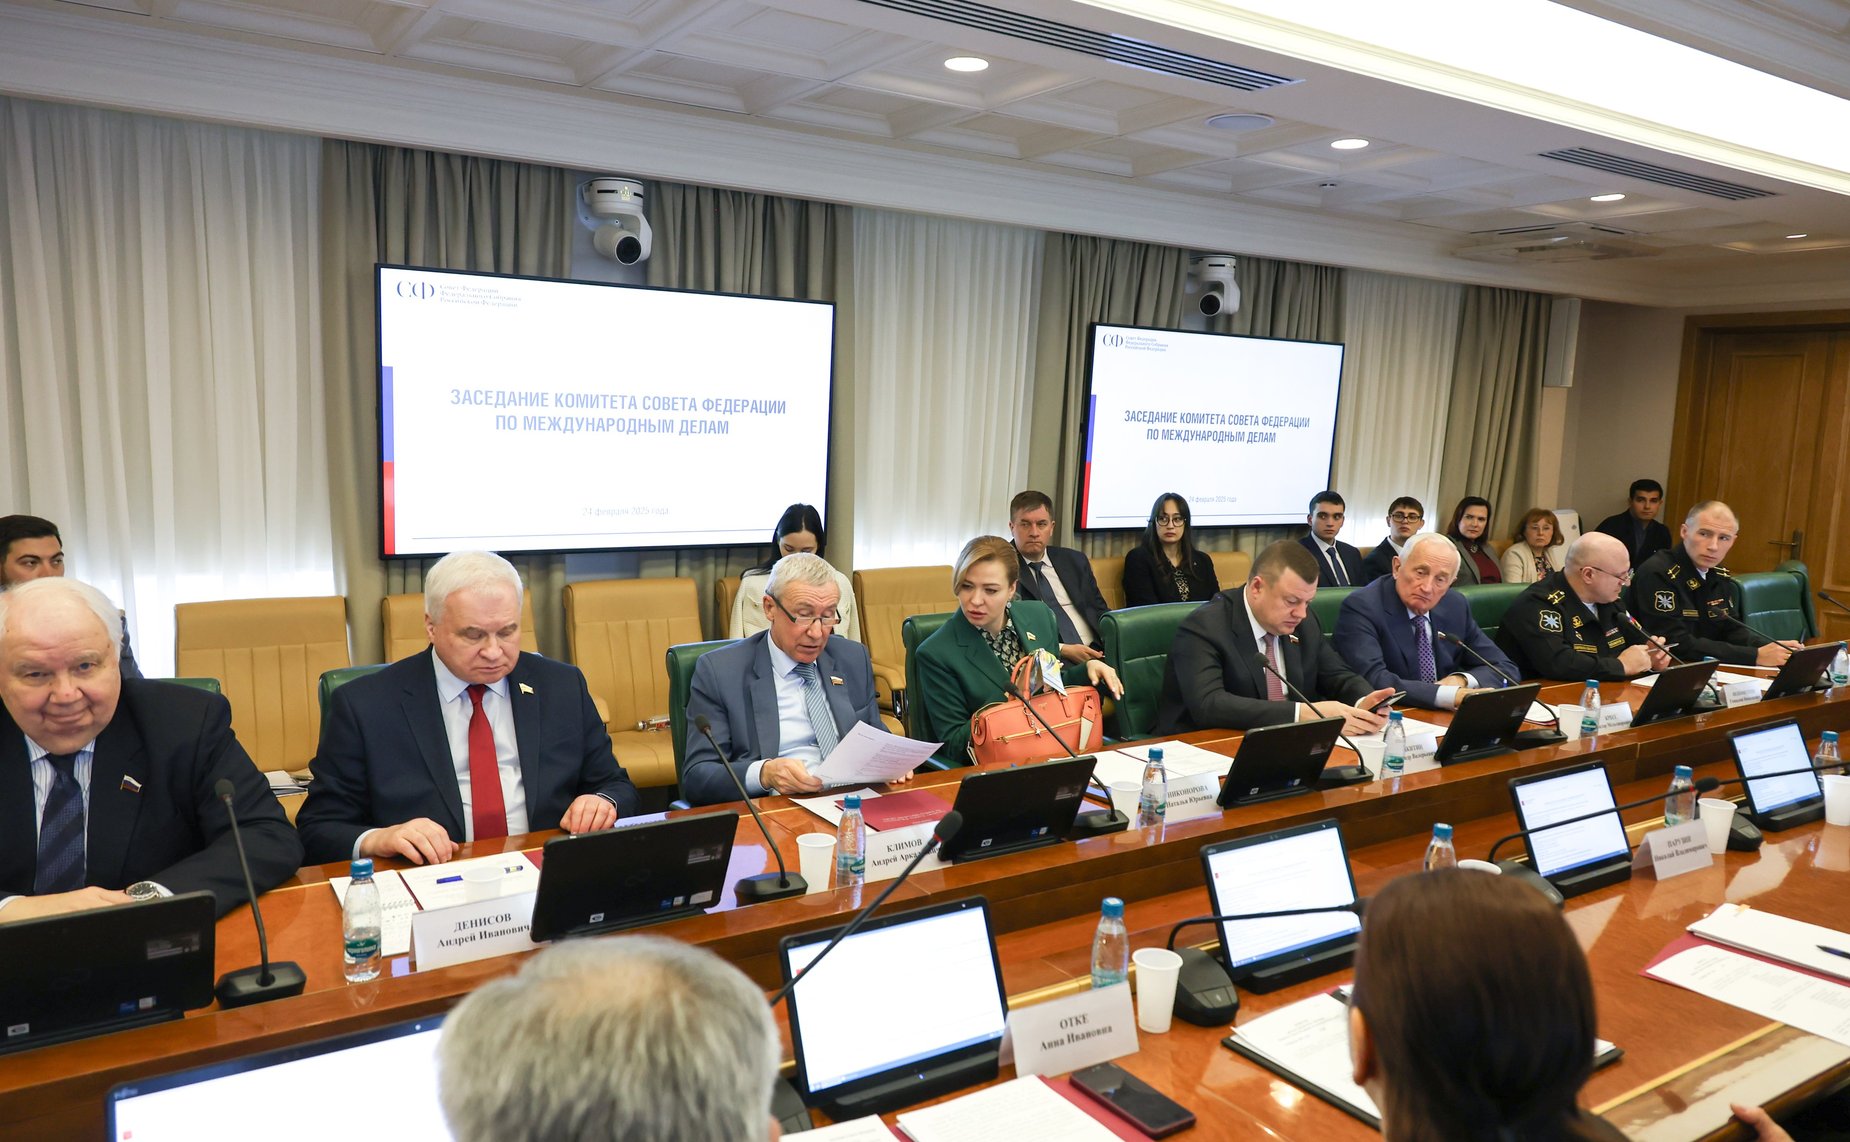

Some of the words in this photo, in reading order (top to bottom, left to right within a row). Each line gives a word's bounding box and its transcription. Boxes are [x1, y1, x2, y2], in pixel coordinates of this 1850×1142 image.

[396, 281, 435, 300] СФ
[1102, 334, 1124, 348] СФ
[450, 389, 549, 409] ЗАСЕДАНИЕ
[555, 393, 638, 410] КОМИТЕТА
[642, 396, 698, 412] СОВЕТА
[702, 398, 786, 416] ФЕДЕРАЦИИ
[496, 415, 518, 431] ПО
[523, 415, 674, 435] МЕЖДУНАРОДНЫМ
[679, 419, 729, 436] ДЕЛАМ
[1124, 410, 1178, 424] ЗАСЕДАНИЕ
[1180, 412, 1226, 425] КОМИТЕТА
[1228, 414, 1259, 426] СОВЕТА
[1261, 416, 1310, 429] ФЕДЕРАЦИИ
[1146, 428, 1159, 441] ПО
[1161, 429, 1245, 443] МЕЖДУНАРОДНЫМ
[1247, 431, 1277, 444] ДЕЛАМ
[886, 838, 923, 853] КЛИМОВ
[871, 856, 898, 868] Андрей
[453, 912, 512, 933] ДЕНИСОВ
[437, 932, 477, 949] Андрей
[479, 924, 531, 941] Иванович
[1059, 1013, 1089, 1030] ОТКЕ
[1040, 1038, 1065, 1052] Анна
[1067, 1025, 1113, 1044] Ивановна
